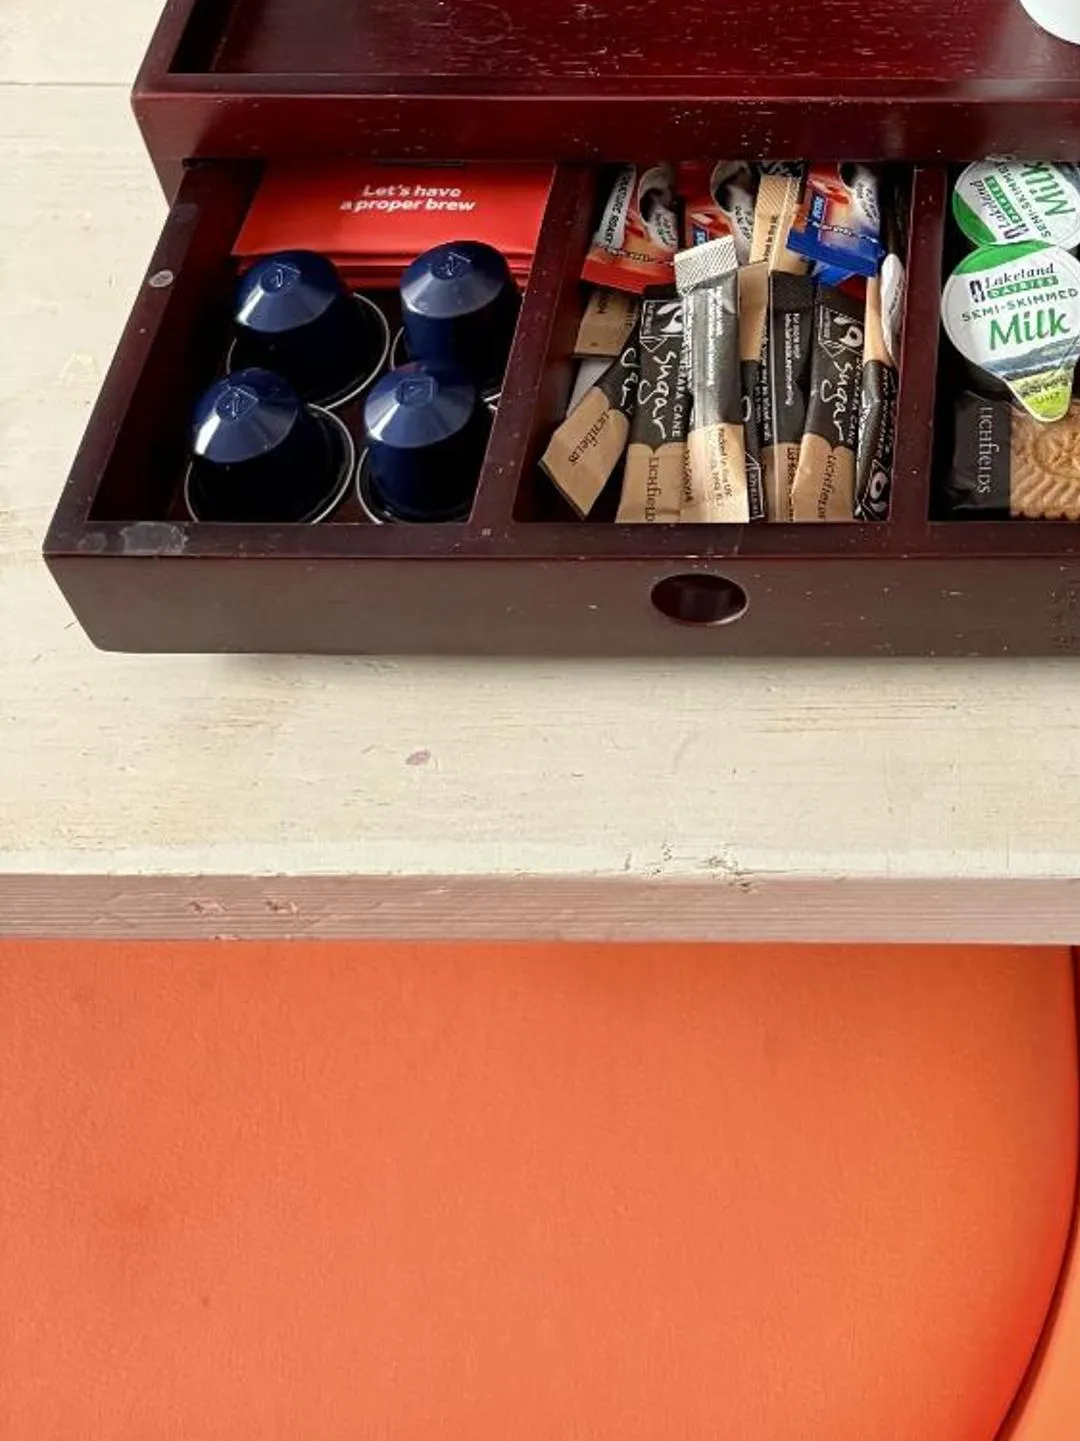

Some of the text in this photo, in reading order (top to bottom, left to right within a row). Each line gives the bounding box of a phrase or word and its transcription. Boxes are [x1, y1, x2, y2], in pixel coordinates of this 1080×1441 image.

[340, 197, 477, 213] a proper brew
[363, 183, 462, 197] Let's have
[1021, 159, 1077, 217] Milk
[969, 179, 1013, 241] Lakeland
[984, 263, 1055, 288] Lakeland
[961, 288, 1079, 322] SEMI-SKIMMED
[989, 310, 1071, 351] Milk
[638, 350, 677, 440] sugar
[820, 360, 853, 440] sugar
[671, 403, 684, 438] CANE
[847, 415, 857, 445] CANE
